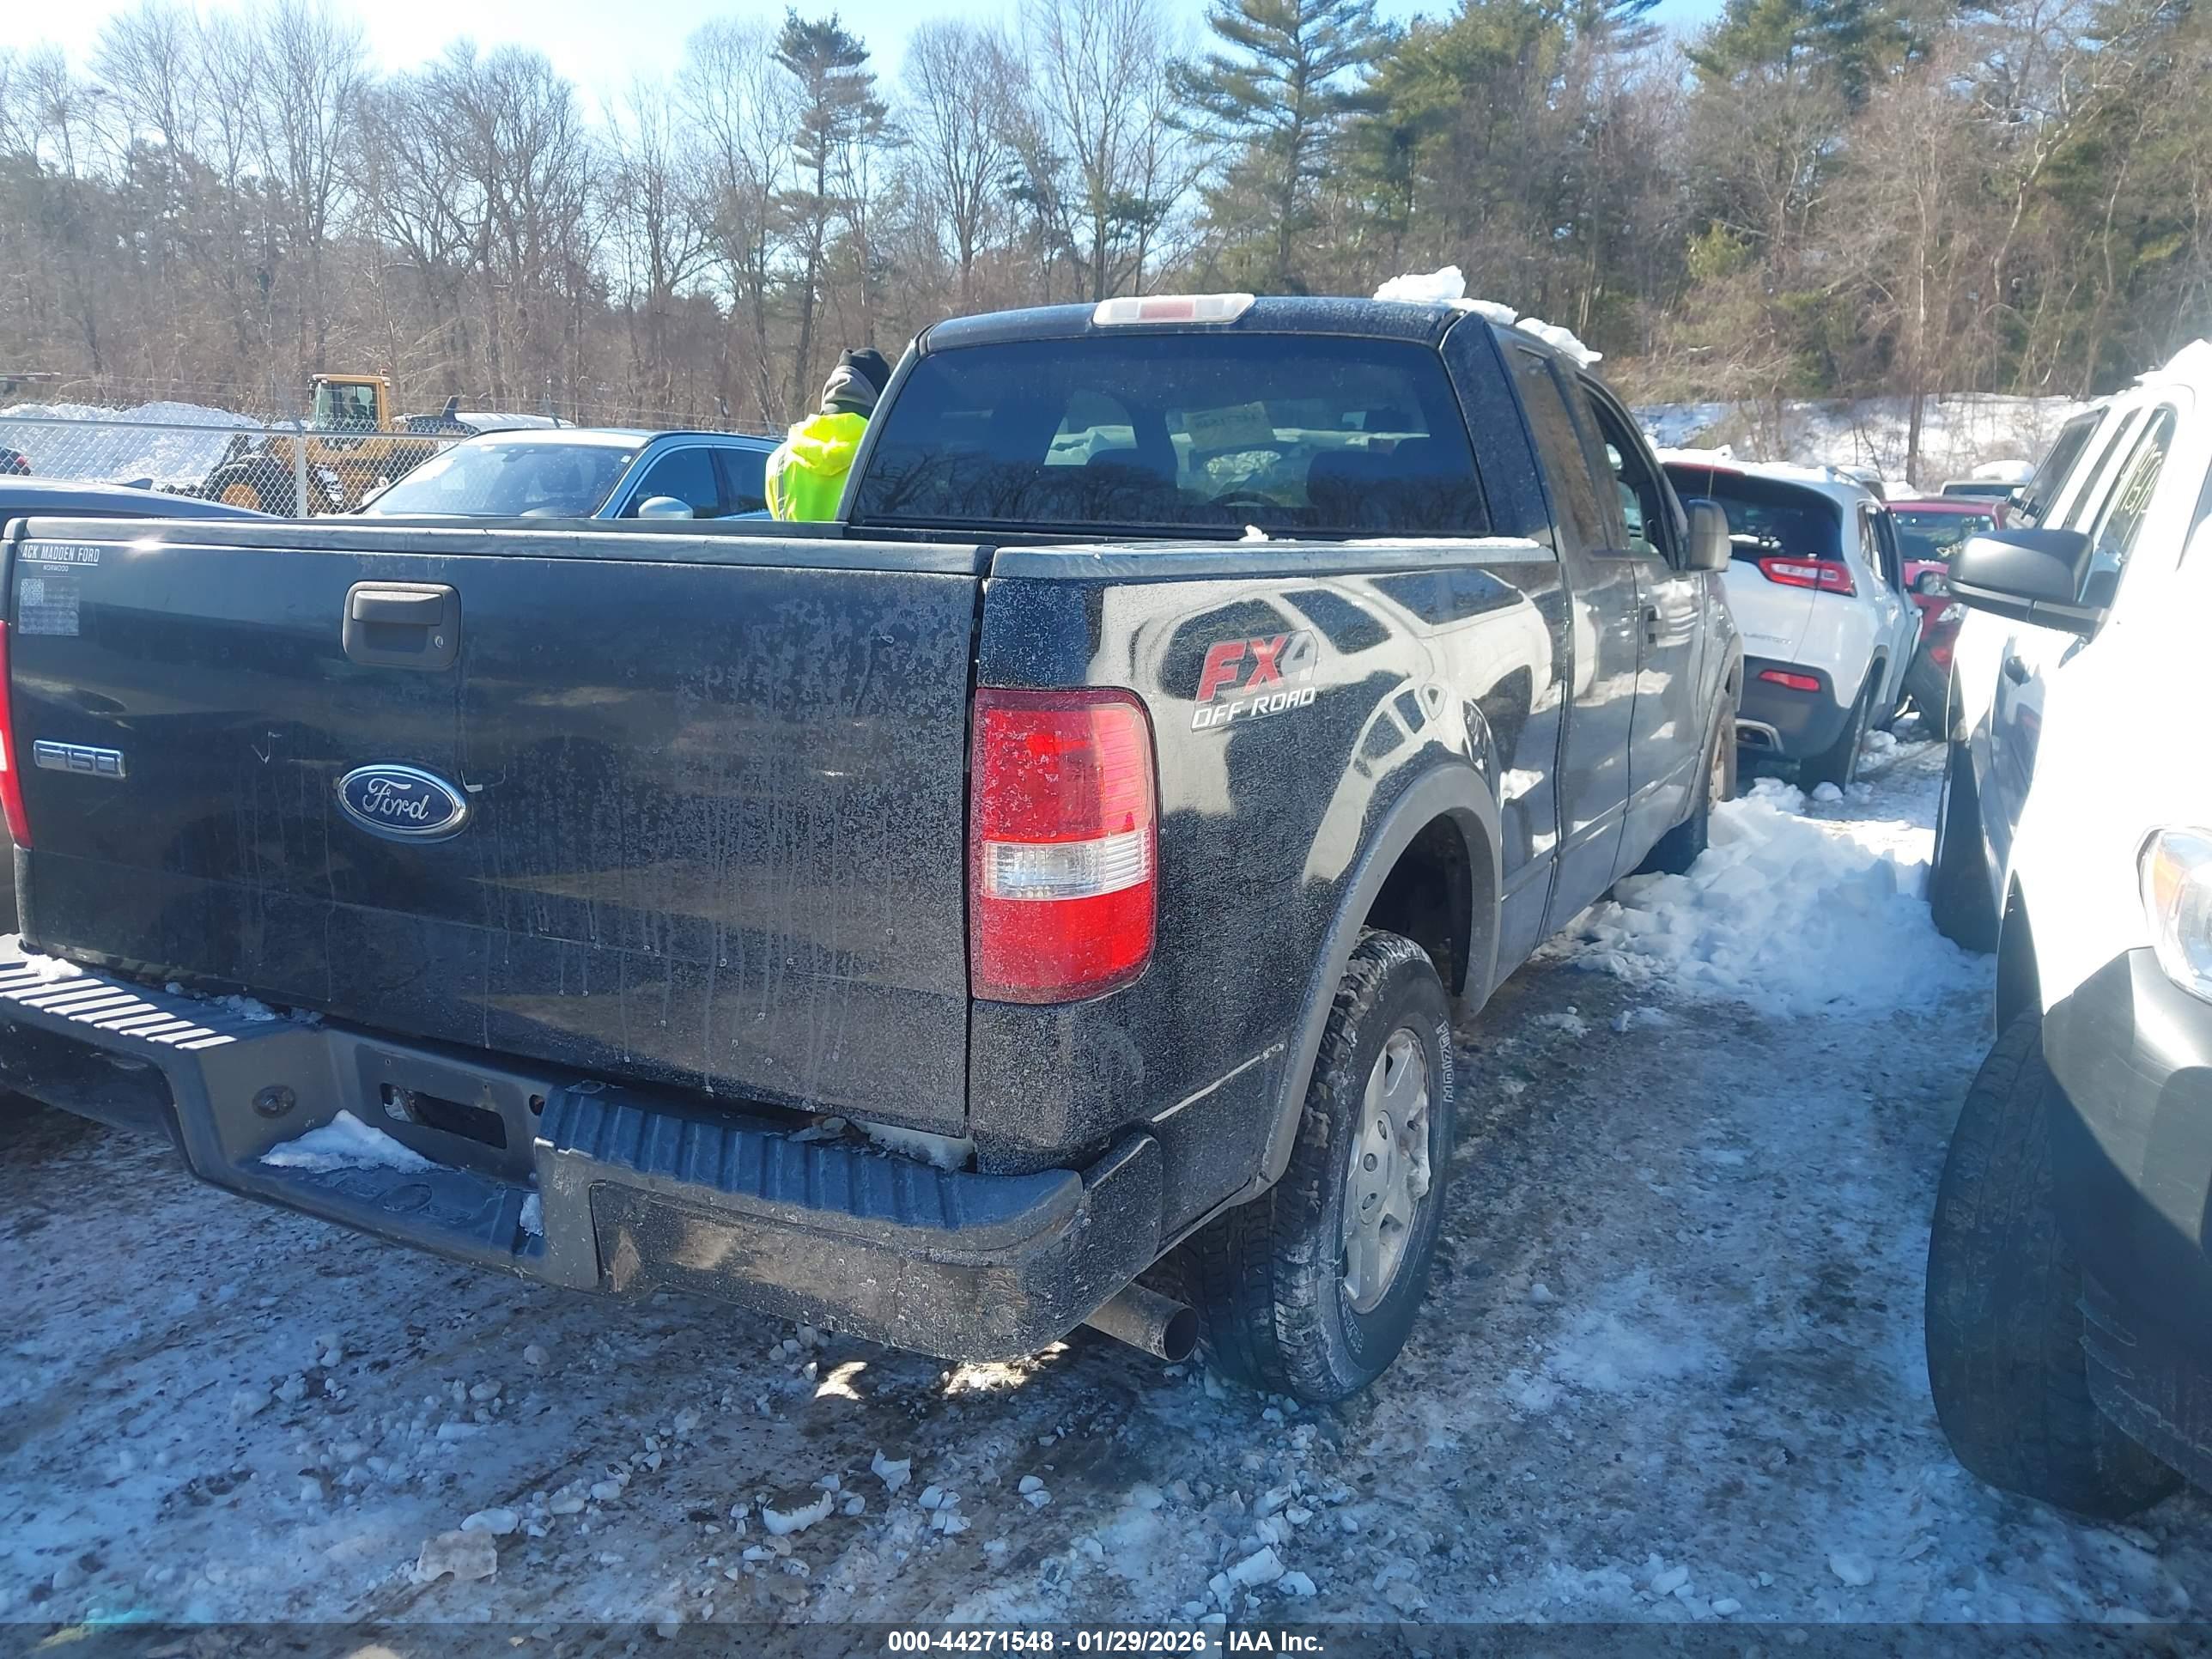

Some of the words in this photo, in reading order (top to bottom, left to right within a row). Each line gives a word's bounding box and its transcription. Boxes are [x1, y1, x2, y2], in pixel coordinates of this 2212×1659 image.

[41, 545, 75, 561] MADDEN
[77, 548, 100, 562] FORD
[1194, 630, 1316, 704] FX4
[1191, 701, 1244, 729] OFF
[1250, 687, 1316, 718] ROAD
[362, 777, 429, 820] Ford
